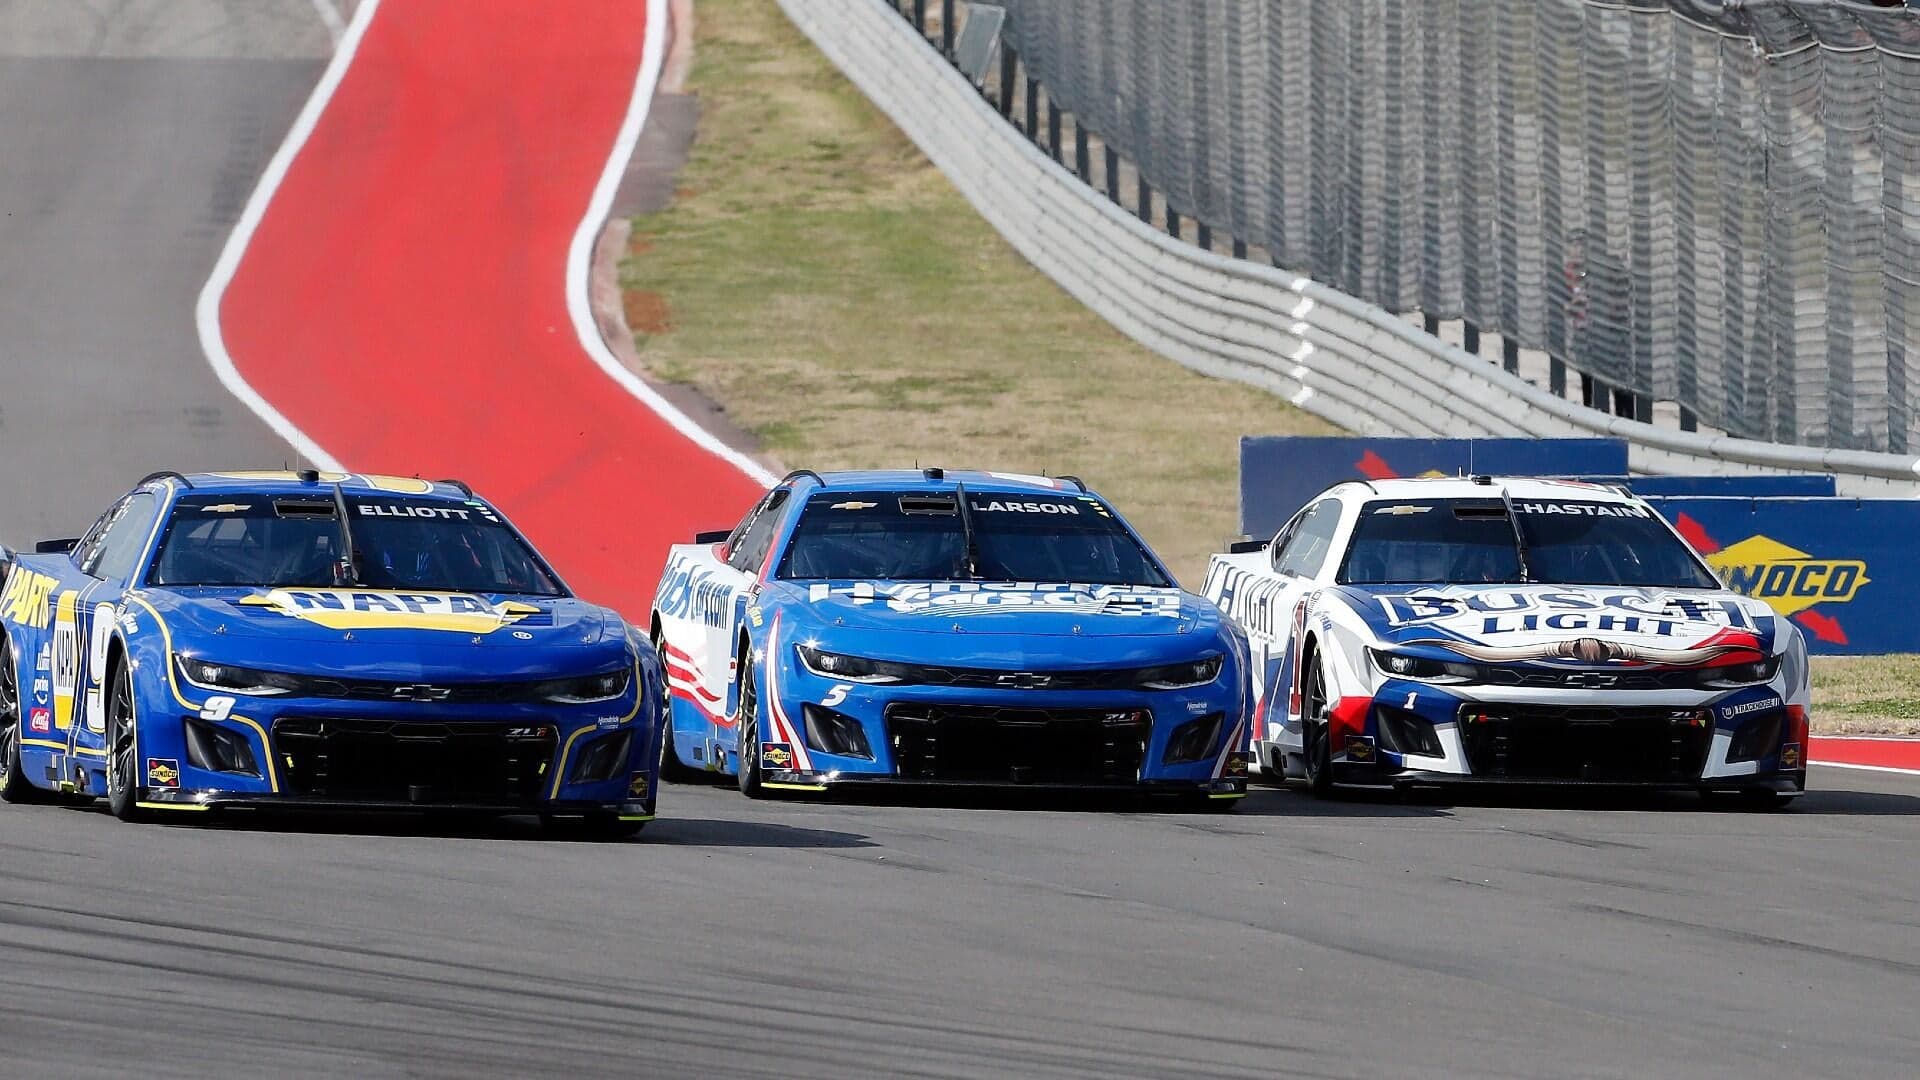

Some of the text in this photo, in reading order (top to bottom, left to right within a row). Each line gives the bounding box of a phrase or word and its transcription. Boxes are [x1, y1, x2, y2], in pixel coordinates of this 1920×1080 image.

[358, 504, 469, 520] ELLIOTT
[971, 501, 1079, 515] LARSON
[1722, 564, 1861, 597] NOCO
[288, 592, 500, 616] NAPA
[1376, 591, 1757, 628] BUSCH
[1482, 613, 1685, 636] LIGHT
[820, 684, 854, 707] 5
[1403, 691, 1418, 710] 1
[199, 695, 237, 722] 9
[150, 770, 177, 778] SUNOCO
